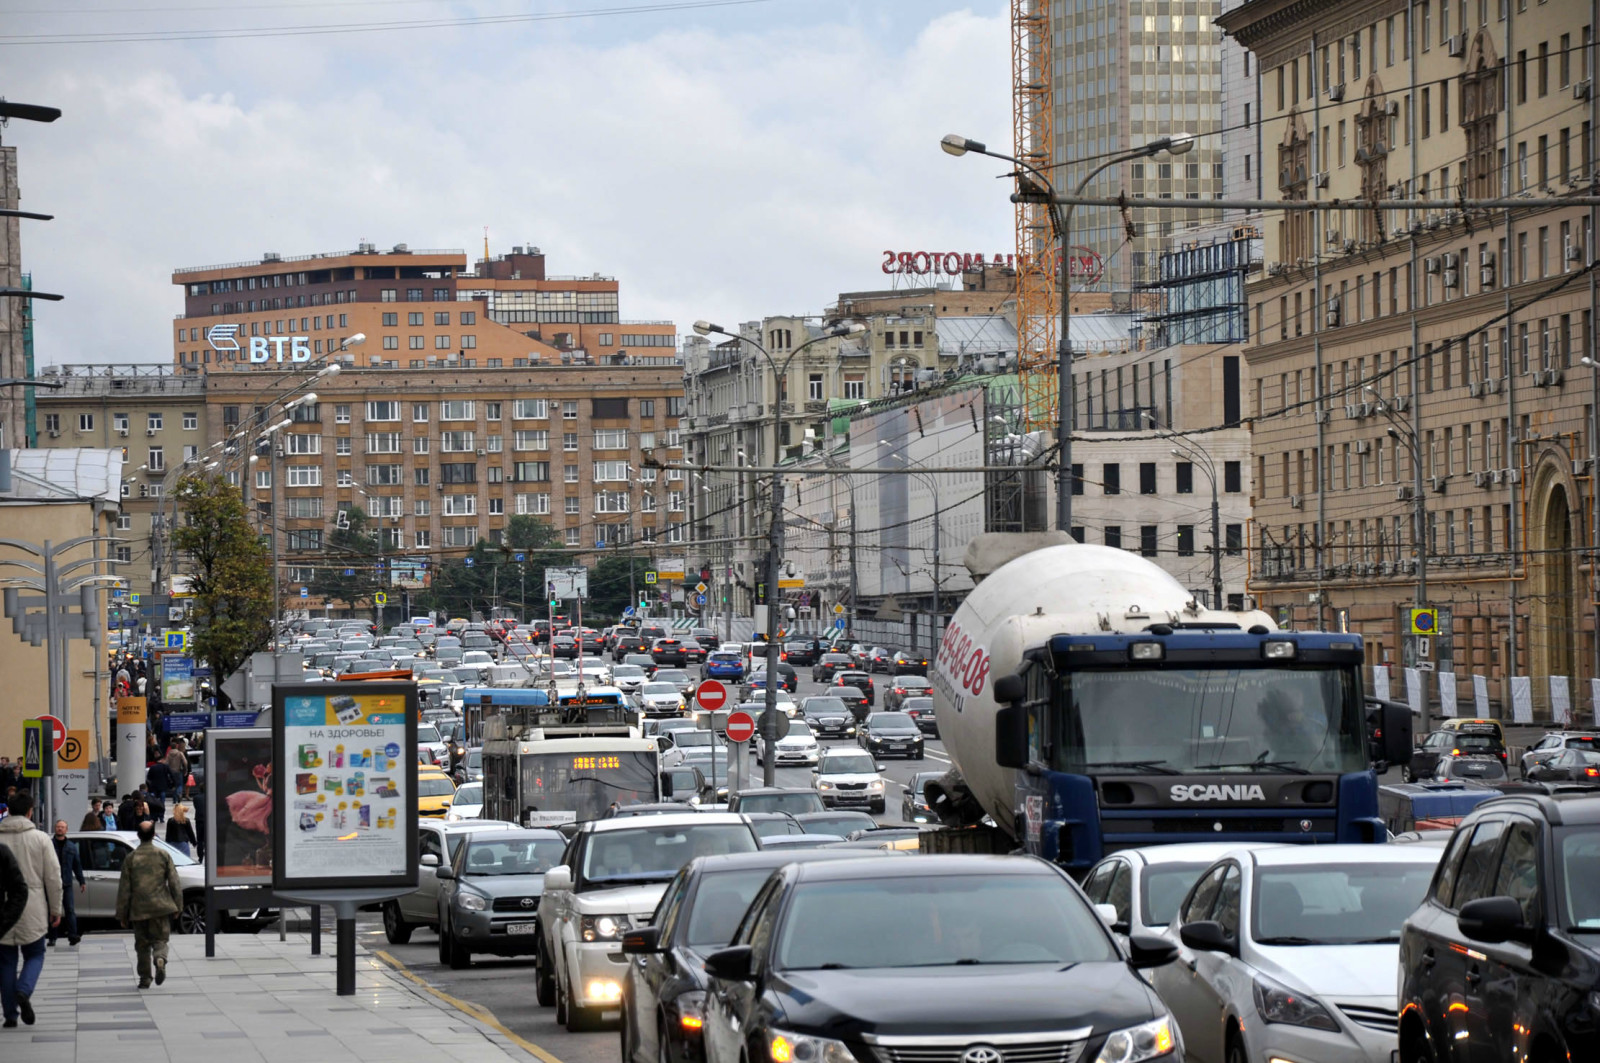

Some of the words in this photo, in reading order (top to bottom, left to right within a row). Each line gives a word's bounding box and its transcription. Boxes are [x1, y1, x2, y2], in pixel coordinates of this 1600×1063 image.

[250, 336, 311, 363] ВТБ
[310, 730, 324, 738] НА
[328, 729, 385, 739] ЗДОРОВЬЕ!
[1170, 784, 1266, 801] SCANIA
